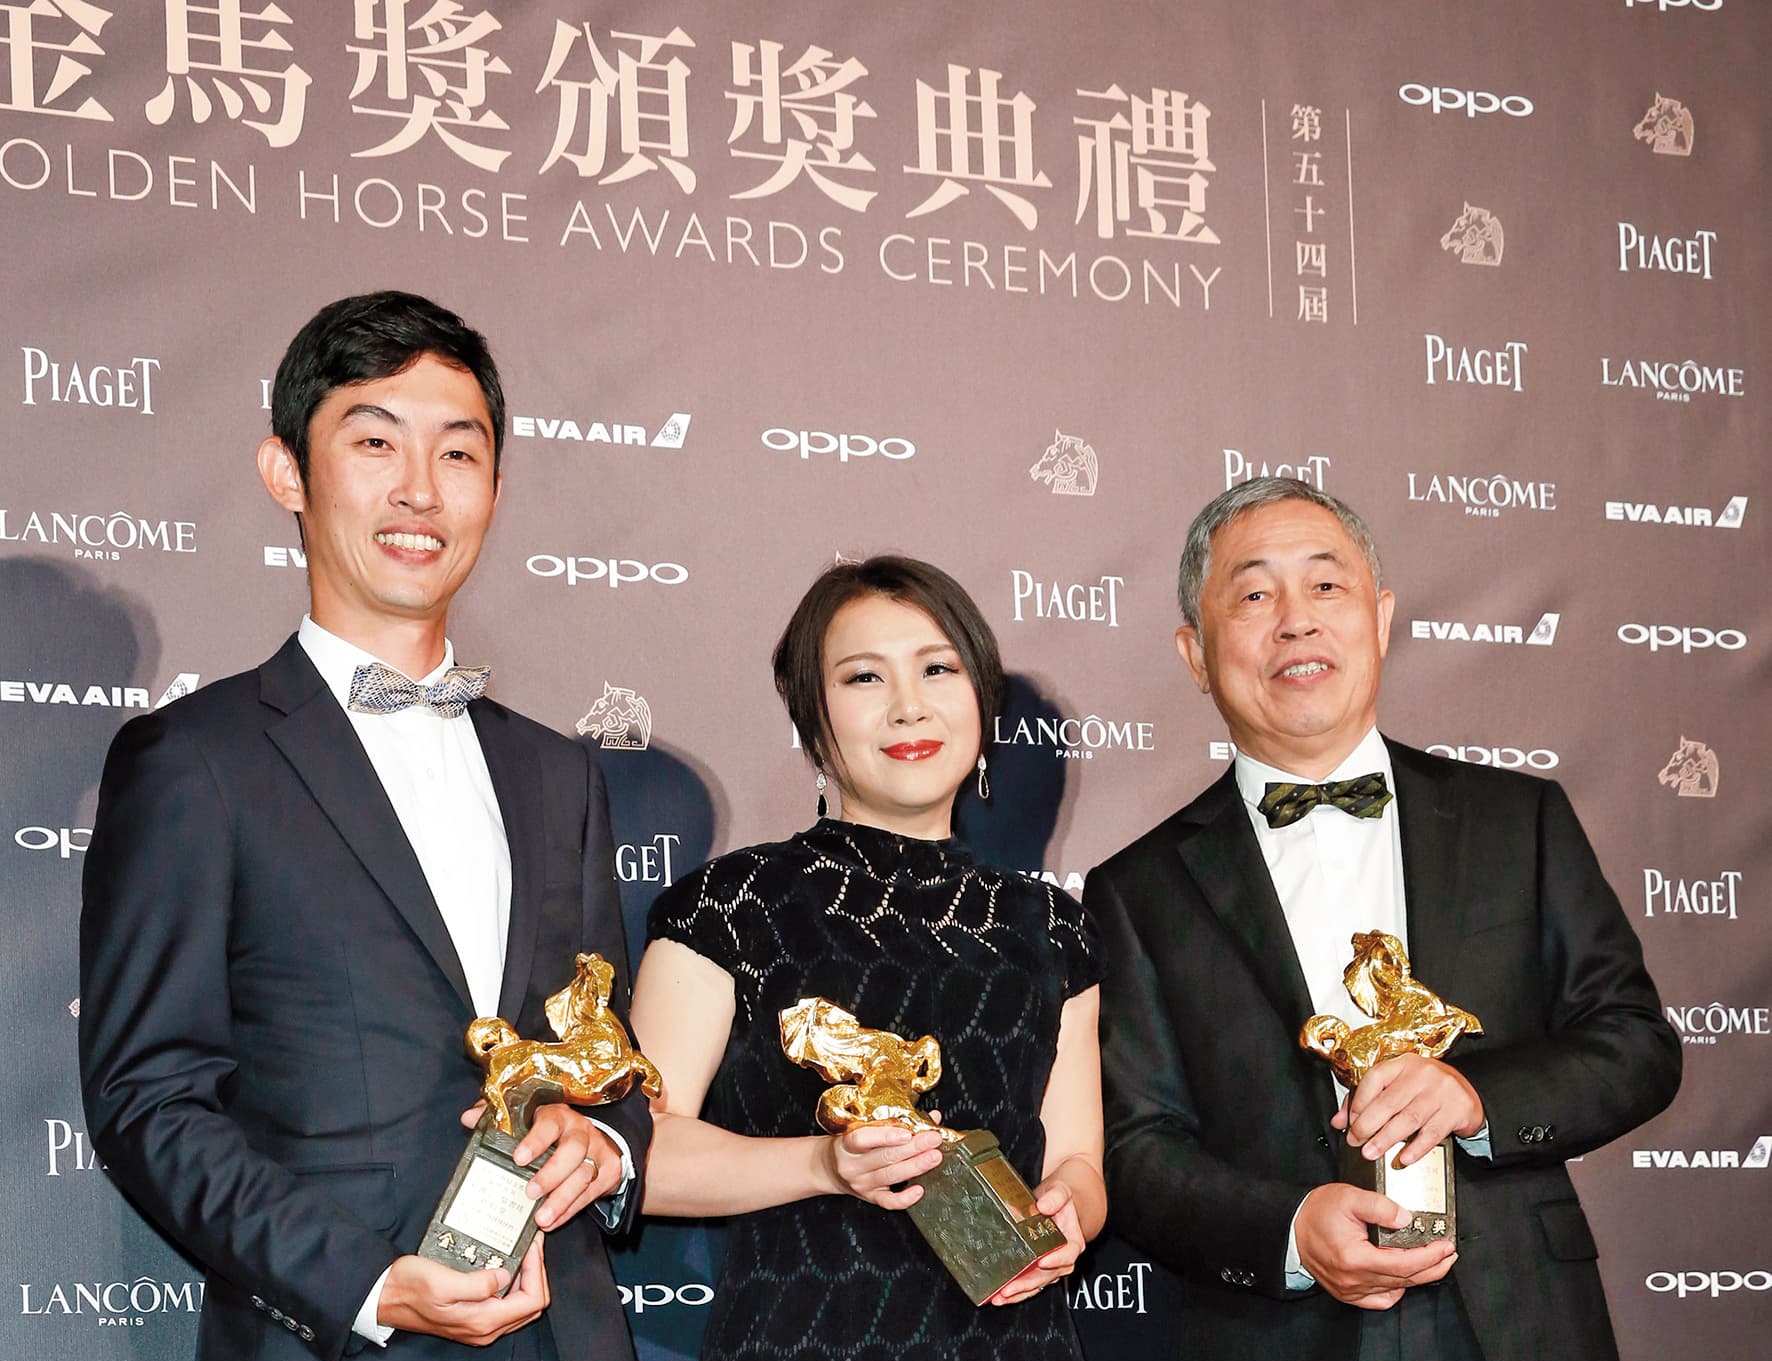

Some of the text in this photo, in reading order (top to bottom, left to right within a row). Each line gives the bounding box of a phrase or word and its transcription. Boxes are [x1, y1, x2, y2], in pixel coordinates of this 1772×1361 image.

[0, 138, 1222, 310] OLDEN HORSE AWARDS CEREMONY
[1291, 103, 1328, 324] 第五十四屆
[1655, 391, 1691, 403] PARIS
[1464, 506, 1500, 518] PARIS
[0, 509, 197, 553] LANCÔME
[74, 549, 121, 561] PARIS
[1055, 749, 1094, 760] PARIS
[15, 826, 93, 859] op
[613, 834, 681, 888] GET
[1666, 1001, 1770, 1034] NCÔME
[1682, 1035, 1717, 1045] PARIS
[1066, 1262, 1153, 1314] AGET
[98, 1317, 144, 1327] PARIS
